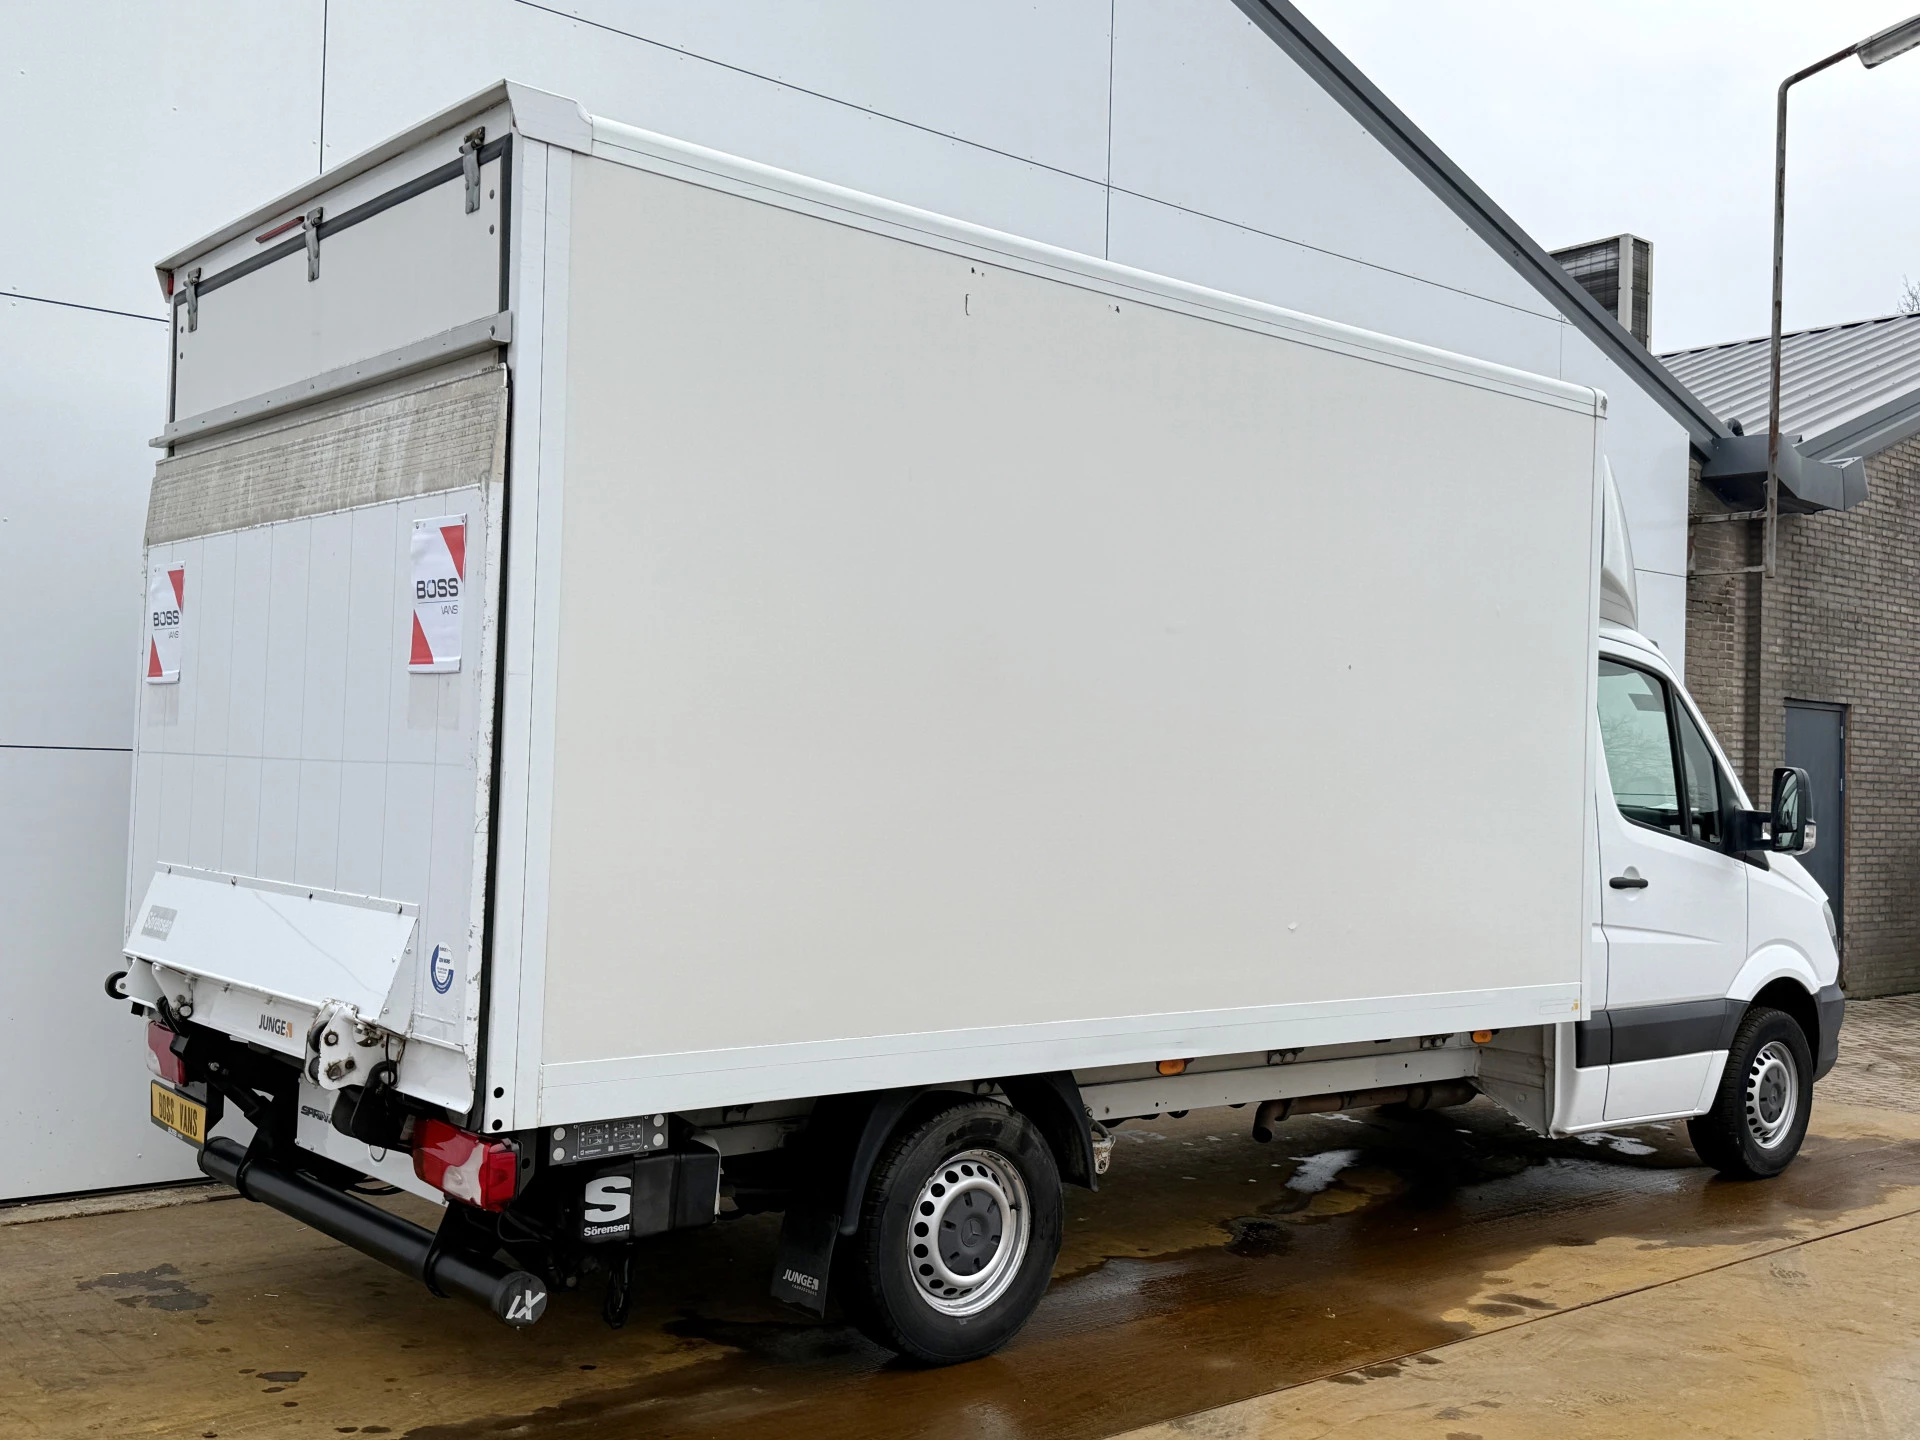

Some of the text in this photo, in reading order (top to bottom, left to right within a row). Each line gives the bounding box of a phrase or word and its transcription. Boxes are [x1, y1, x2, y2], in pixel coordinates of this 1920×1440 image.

[416, 577, 459, 600] BOSS
[153, 609, 180, 627] BOSS
[441, 604, 459, 615] VANS
[258, 1013, 287, 1037] JUNGE
[158, 1092, 175, 1126] BOSS
[179, 1102, 198, 1137] VANS
[584, 1175, 632, 1223] S
[583, 1223, 630, 1237] Sörensen
[782, 1268, 814, 1288] JUNGE
